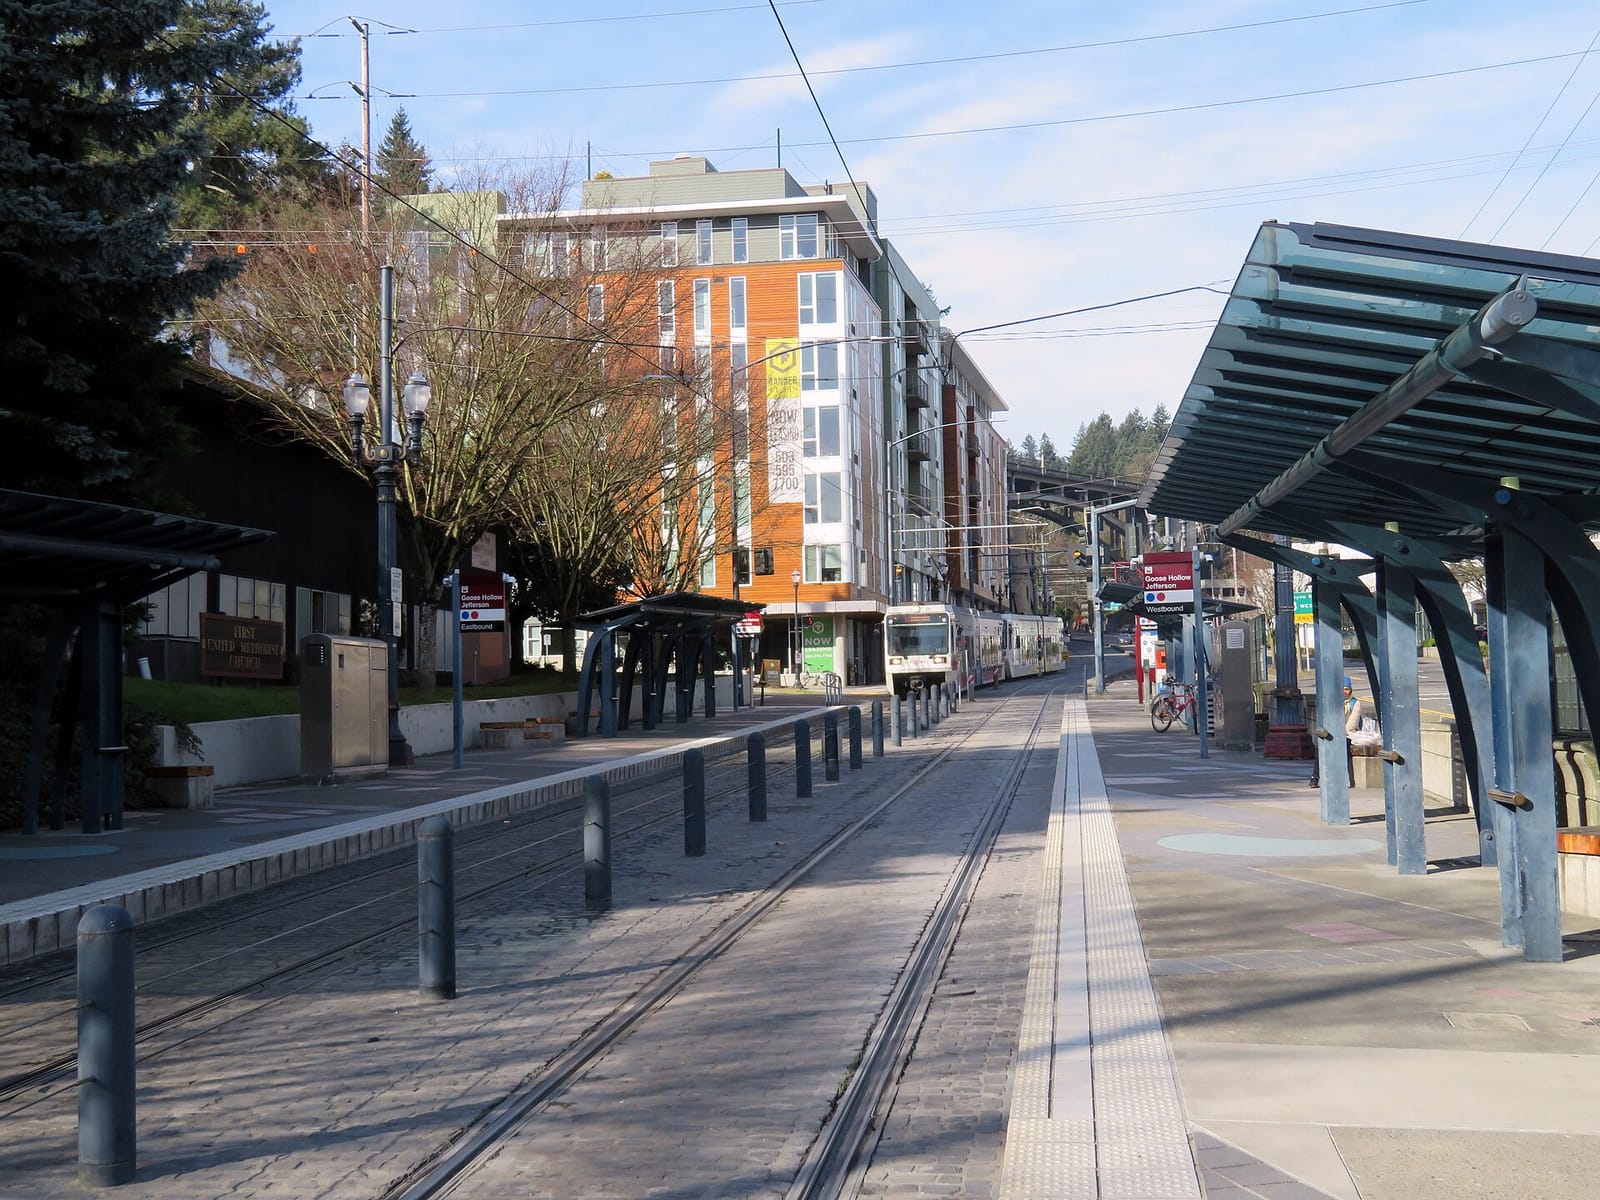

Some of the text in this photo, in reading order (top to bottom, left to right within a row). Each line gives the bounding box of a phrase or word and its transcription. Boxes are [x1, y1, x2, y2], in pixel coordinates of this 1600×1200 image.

[775, 450, 795, 463] 503
[775, 463, 796, 477] 595
[773, 476, 799, 490] 7700
[461, 601, 490, 609] Jefferson
[1146, 604, 1184, 613] Westbound
[233, 625, 257, 640] FIRST
[207, 638, 236, 653] UNITED
[804, 637, 832, 646] NOW
[229, 654, 262, 671] CHURCH
